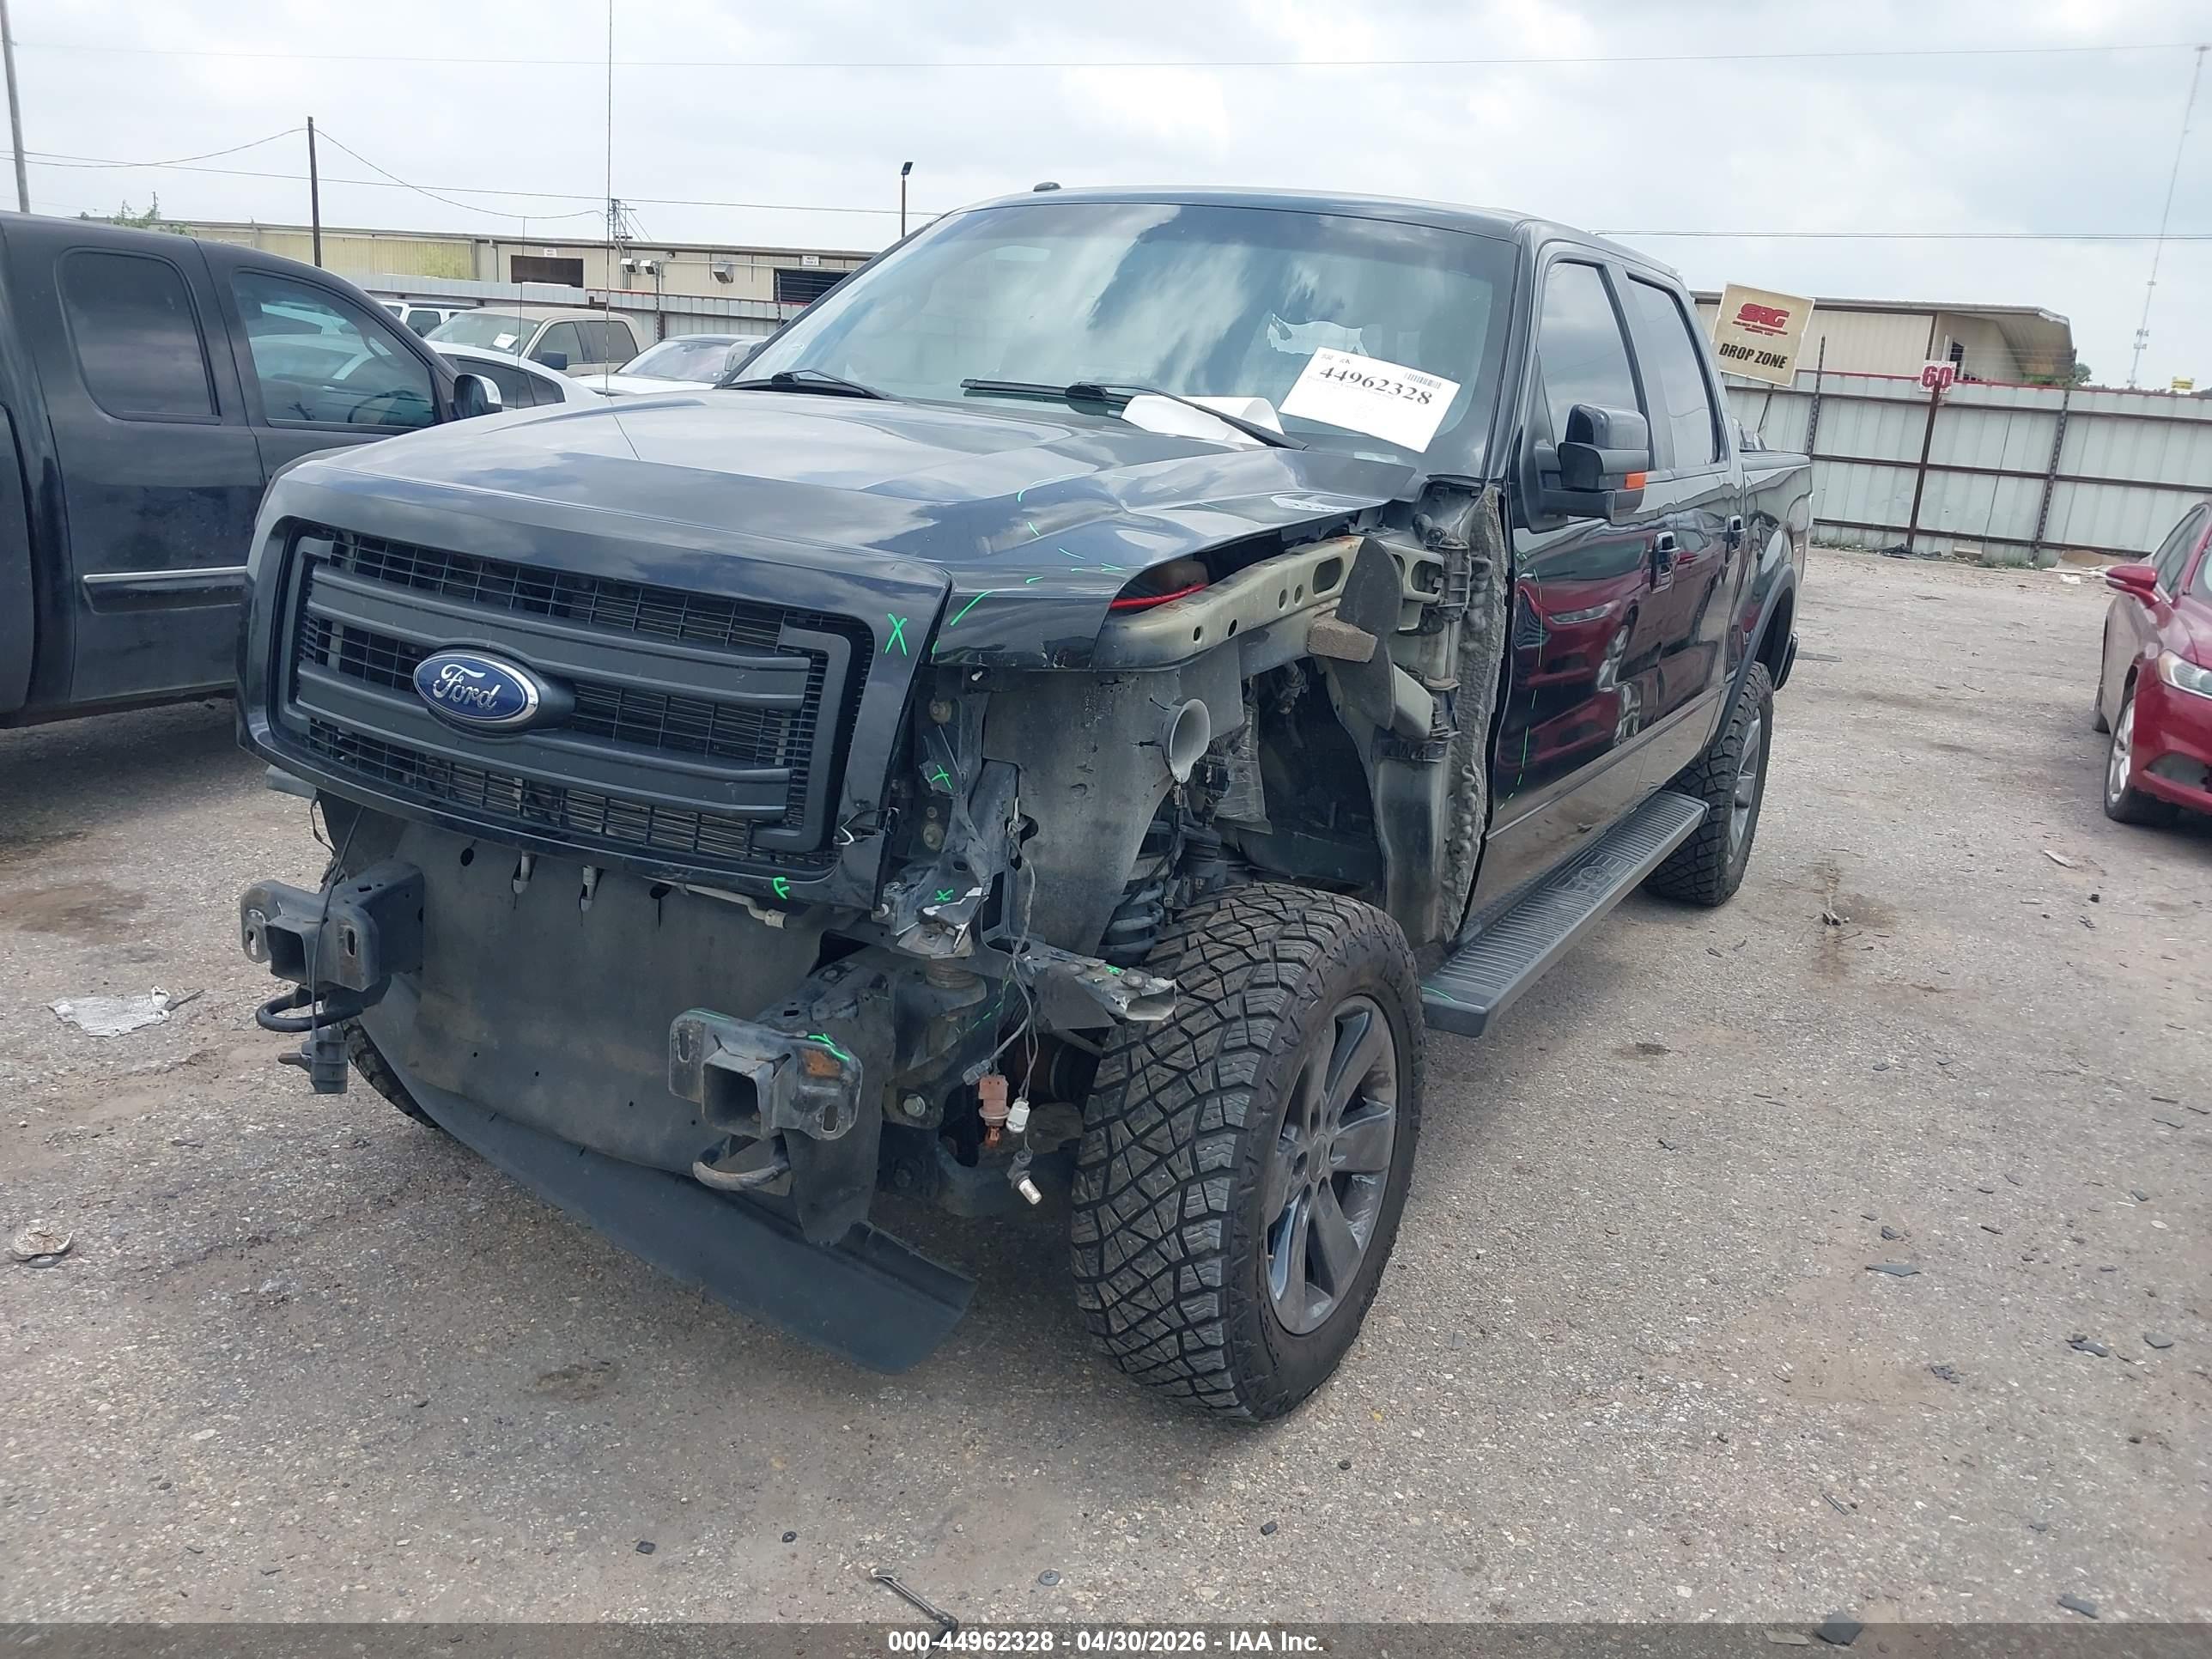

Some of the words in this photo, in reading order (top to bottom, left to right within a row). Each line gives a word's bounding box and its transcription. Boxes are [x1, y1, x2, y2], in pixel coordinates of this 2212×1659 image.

[1736, 303, 1790, 328] SRG
[1719, 343, 1755, 362] DROP
[1754, 350, 1788, 369] ZONE
[1320, 367, 1432, 404] 44962328
[1922, 365, 1953, 389] 60
[433, 664, 501, 709] Ford
